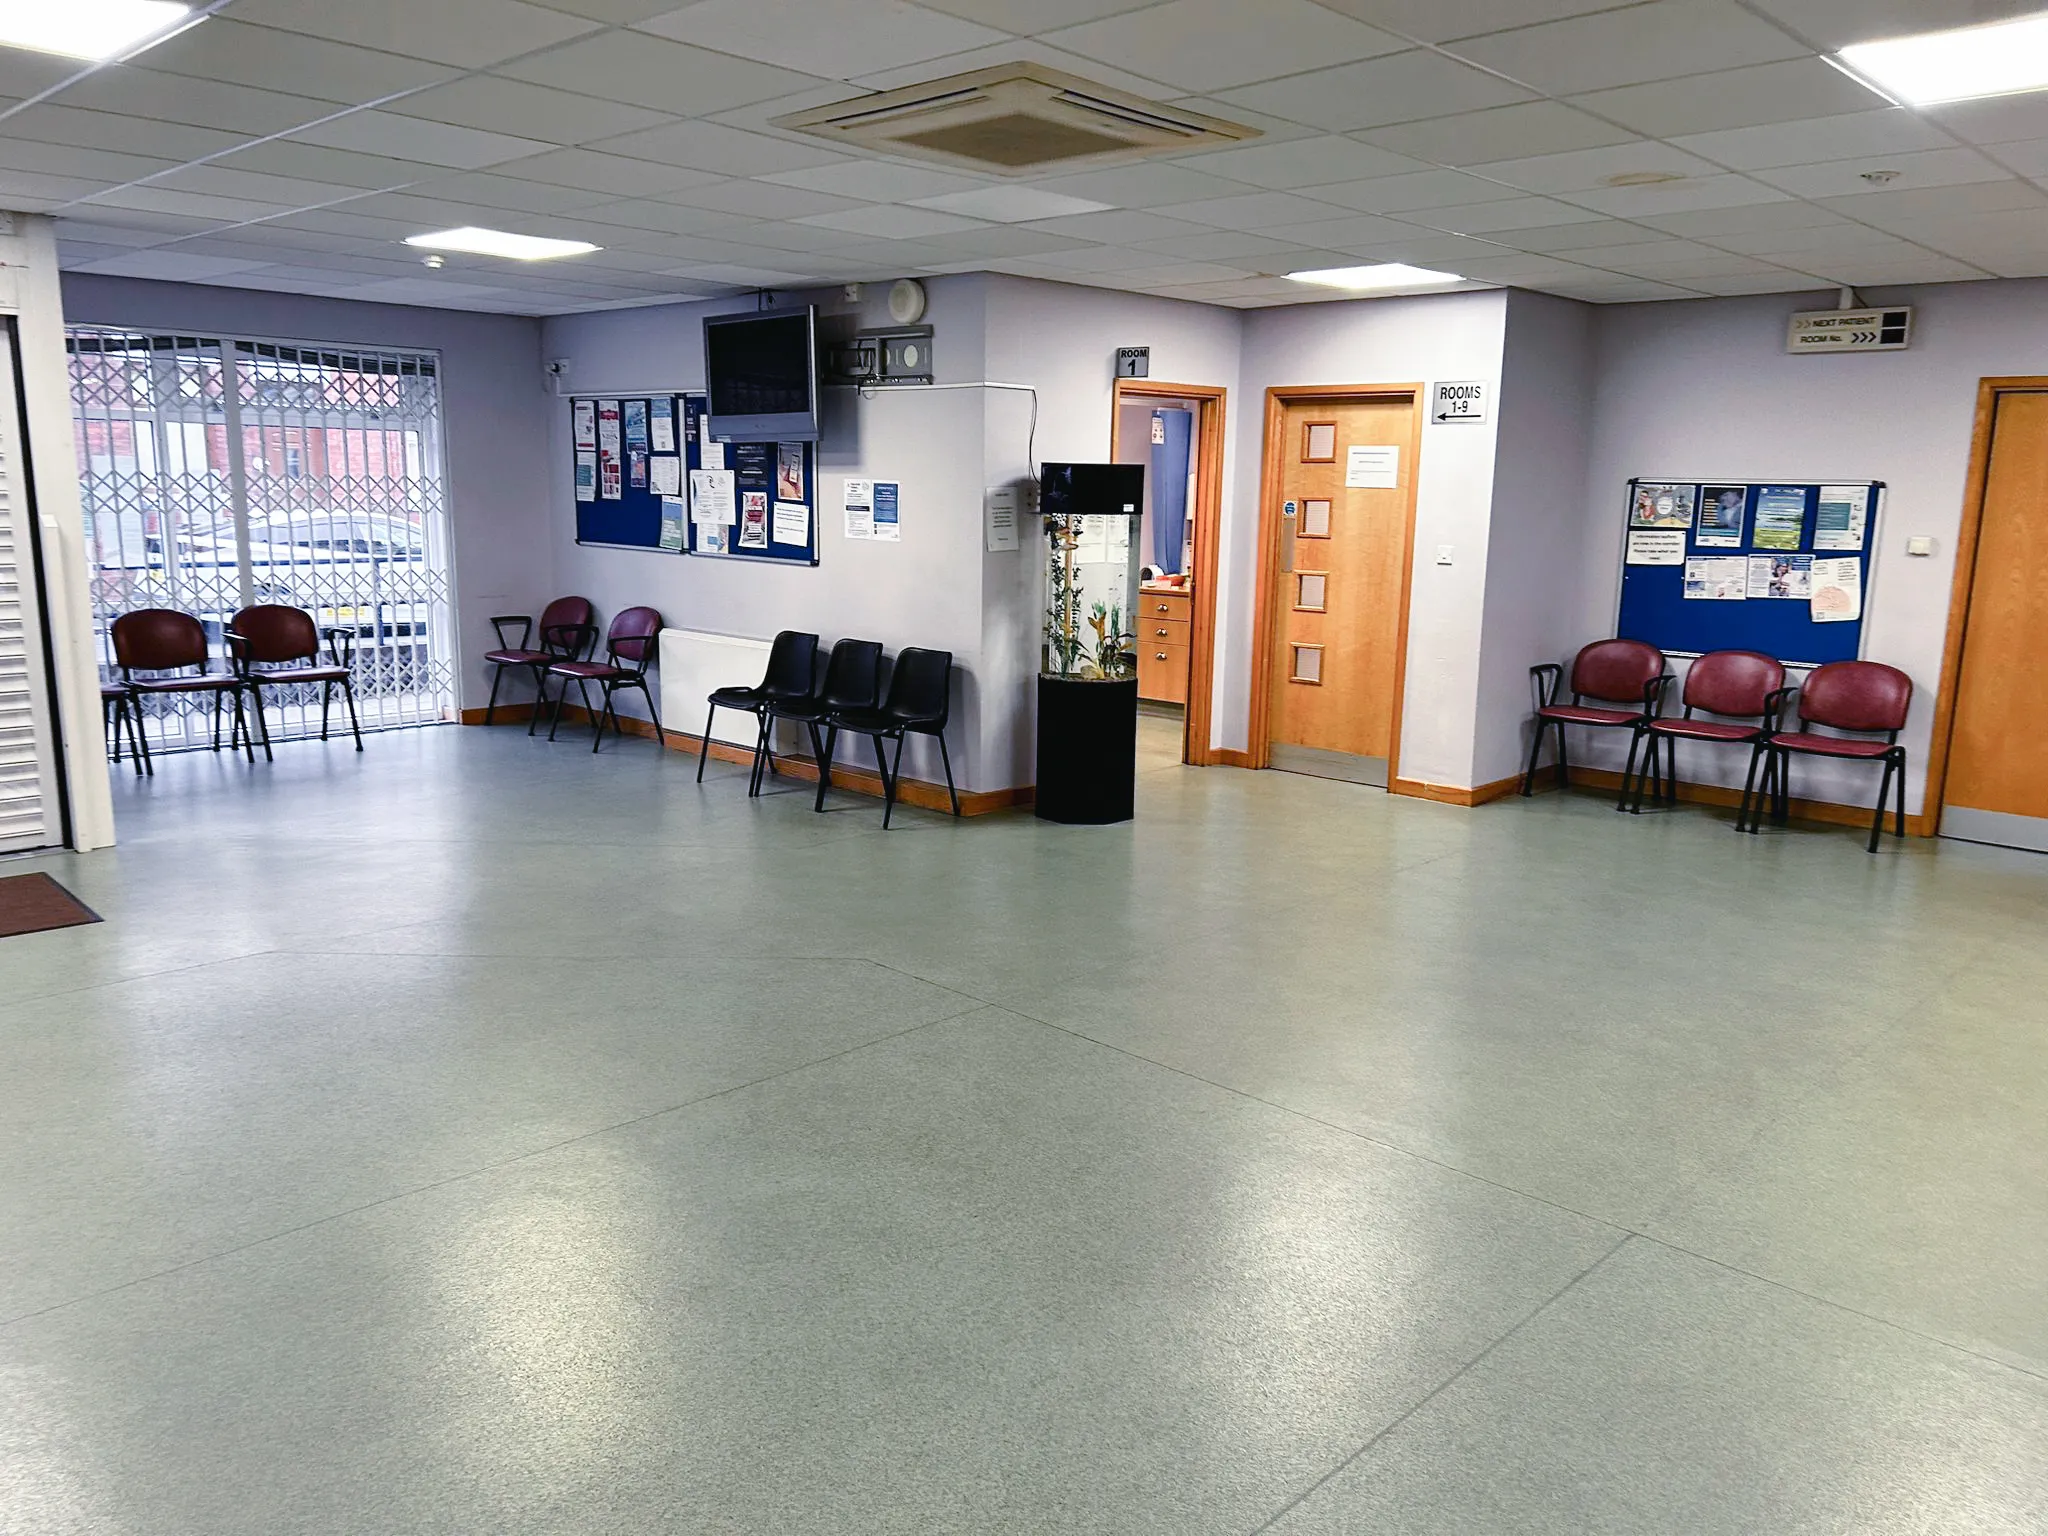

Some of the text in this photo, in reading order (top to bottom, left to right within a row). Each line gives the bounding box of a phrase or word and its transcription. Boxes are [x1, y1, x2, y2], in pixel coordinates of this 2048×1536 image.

[1812, 316, 1876, 327] NEXT PATIENT
[1800, 335, 1827, 343] ROOM
[1121, 349, 1147, 358] ROOM
[1128, 359, 1136, 375] 1
[1440, 385, 1481, 400] ROOMS
[1452, 400, 1468, 413] 1-9
